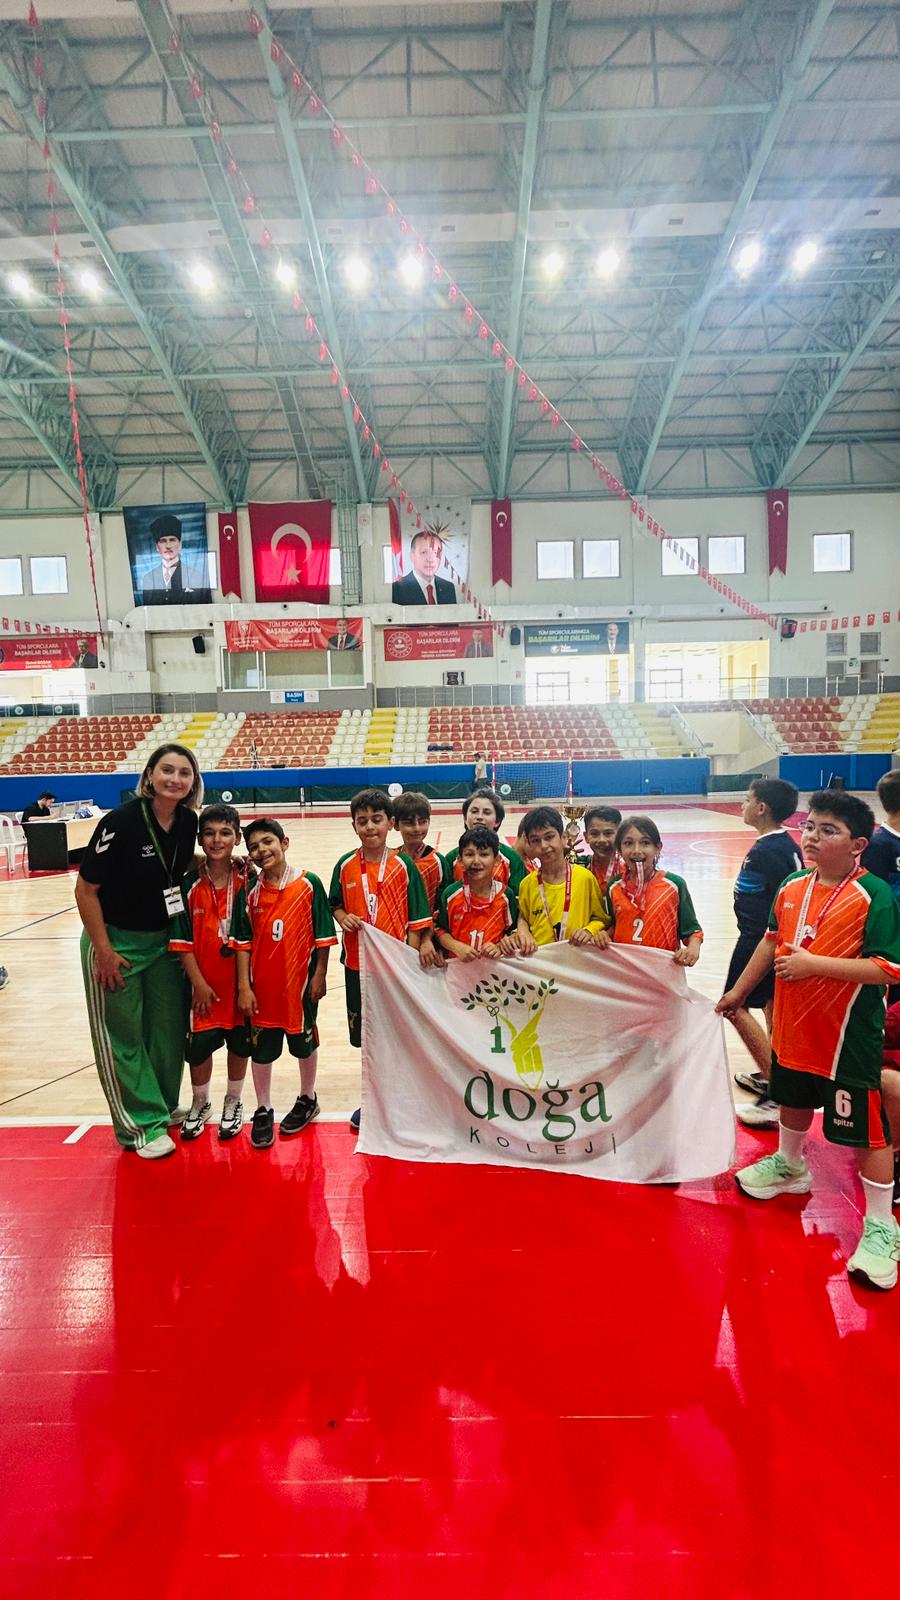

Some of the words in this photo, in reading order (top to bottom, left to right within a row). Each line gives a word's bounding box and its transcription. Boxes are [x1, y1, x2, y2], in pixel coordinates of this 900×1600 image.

[272, 918, 284, 942] 9
[469, 929, 485, 951] 11
[632, 918, 645, 942] 2
[490, 1026, 506, 1053] 1
[464, 1069, 613, 1142] doğa
[835, 1089, 852, 1118] 6
[832, 1118, 854, 1128] spitze
[469, 1126, 617, 1154] KOLEJİ
